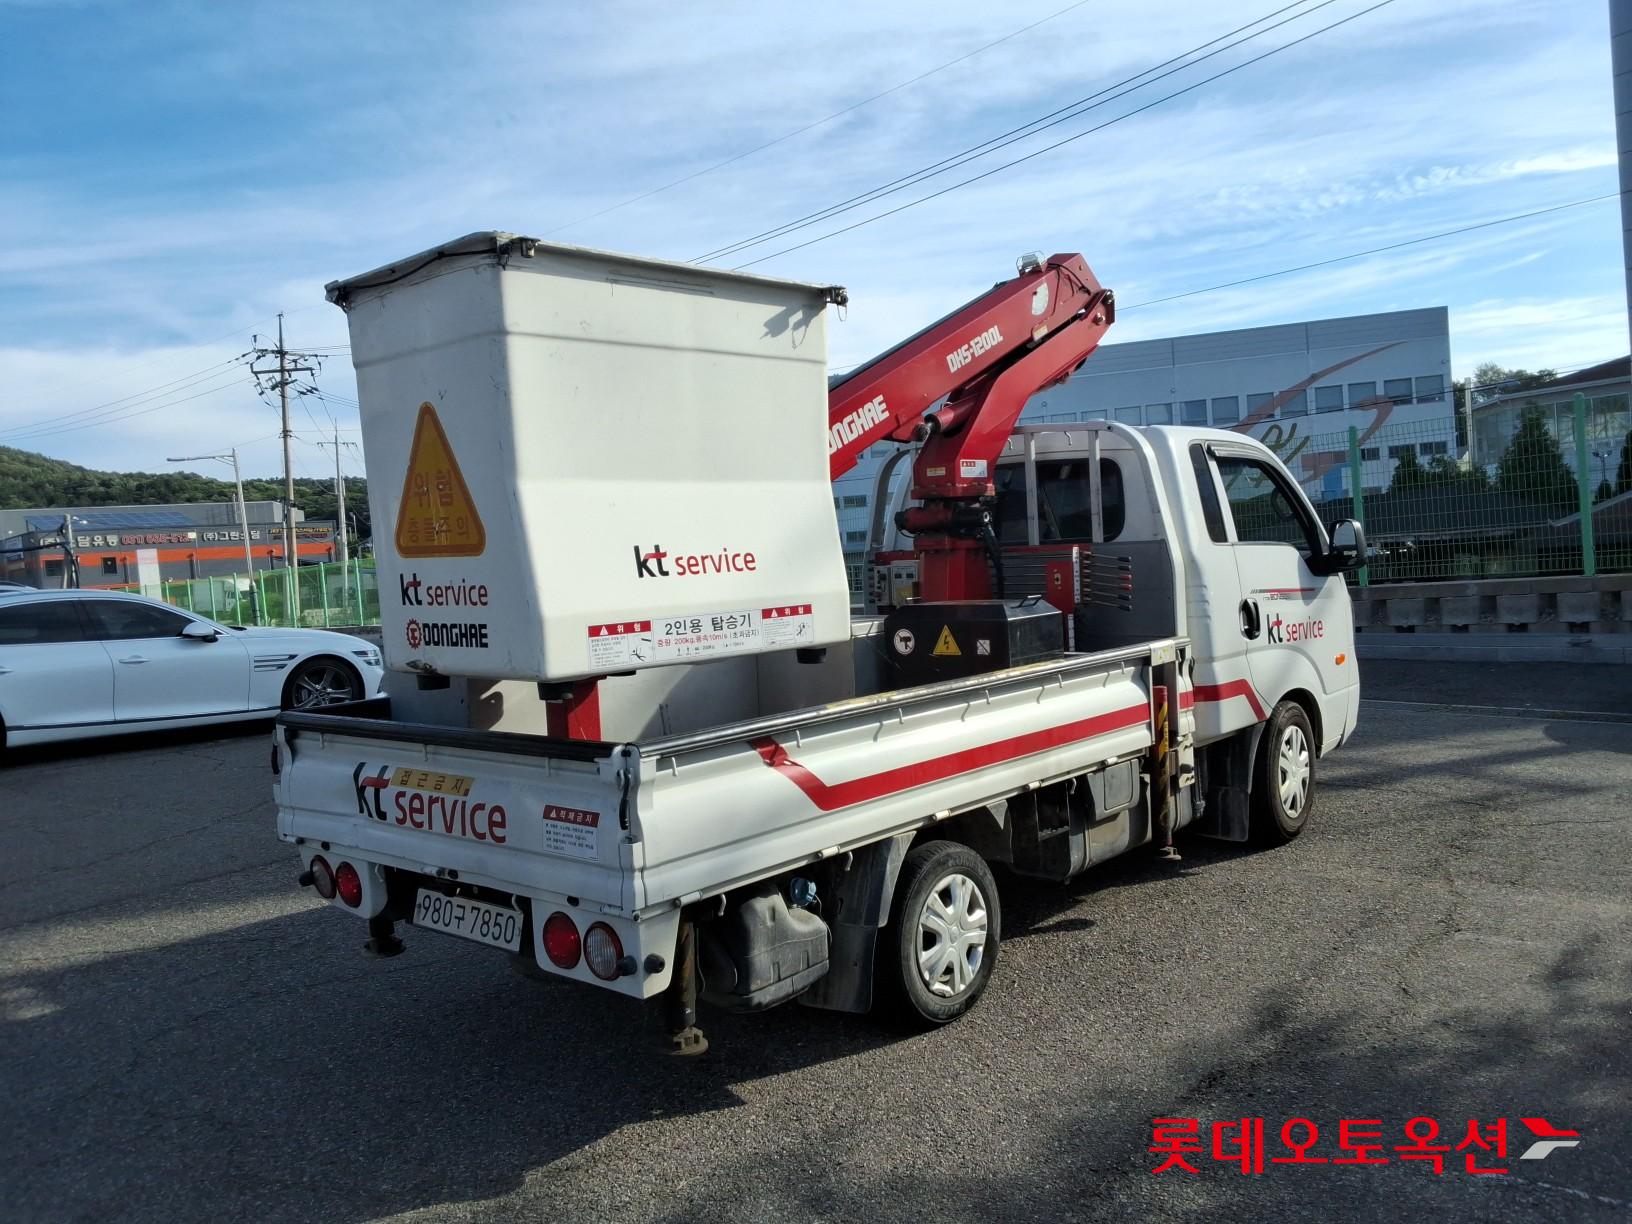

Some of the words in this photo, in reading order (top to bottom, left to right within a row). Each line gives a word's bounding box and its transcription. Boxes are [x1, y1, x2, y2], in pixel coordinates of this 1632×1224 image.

[946, 324, 1004, 373] DHS-1200L
[633, 544, 669, 578] kt
[675, 547, 757, 576] service
[400, 572, 423, 606] kt
[426, 578, 488, 607] service
[422, 622, 489, 649] DONGHAE
[664, 618, 703, 636] 2인용
[711, 612, 752, 632] 탑승기
[1266, 612, 1283, 645] kt
[1286, 615, 1324, 643] service
[353, 762, 391, 821] kt
[394, 788, 507, 844] service
[421, 894, 516, 944] 980구7850
